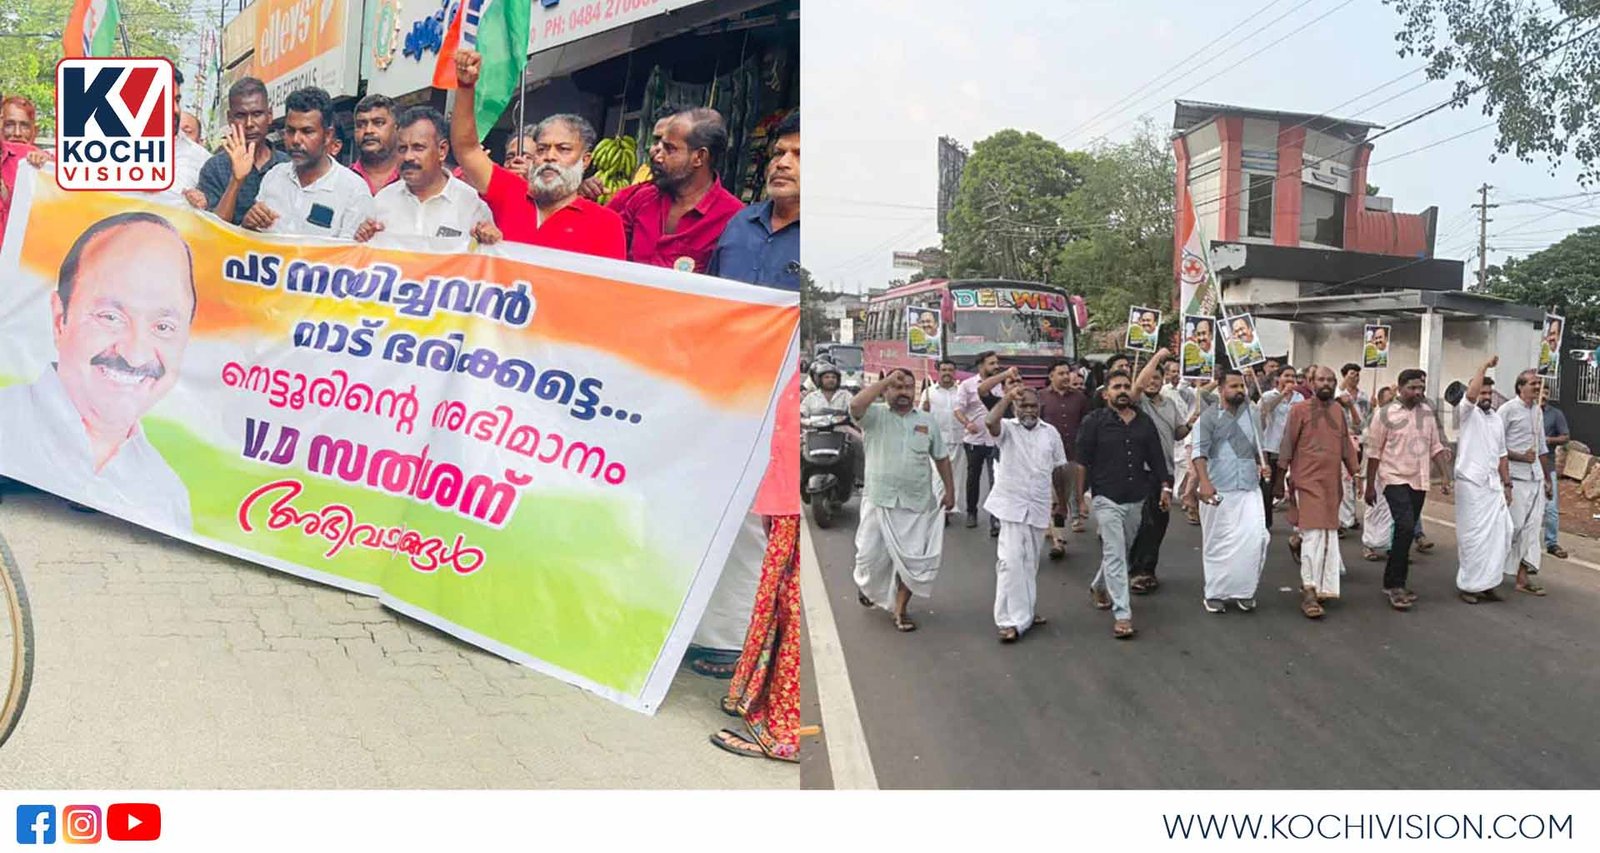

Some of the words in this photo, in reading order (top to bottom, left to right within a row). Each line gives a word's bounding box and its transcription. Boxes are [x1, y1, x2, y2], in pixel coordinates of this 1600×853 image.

[225, 254, 279, 284] പട
[287, 260, 532, 325] നയിച്ചവൻ
[951, 288, 1065, 312] DELWIN
[243, 416, 300, 465] V.D
